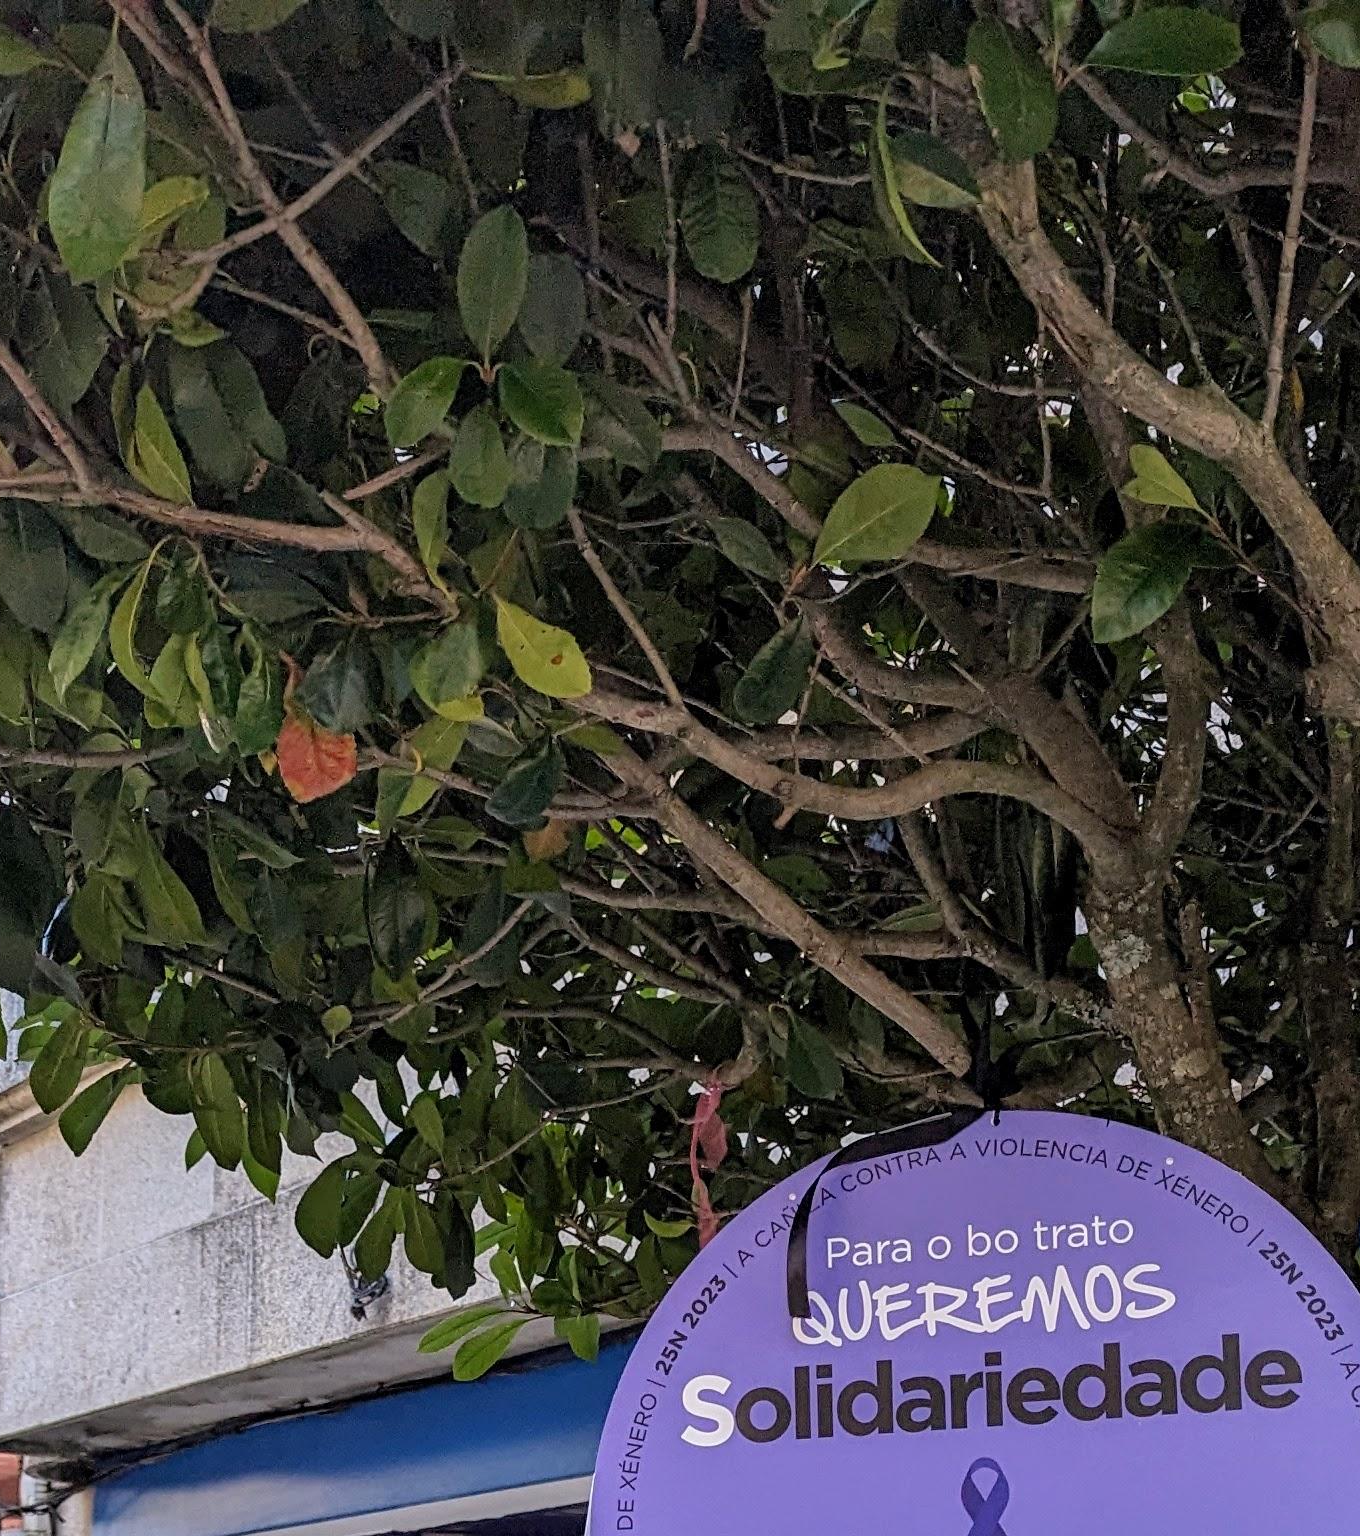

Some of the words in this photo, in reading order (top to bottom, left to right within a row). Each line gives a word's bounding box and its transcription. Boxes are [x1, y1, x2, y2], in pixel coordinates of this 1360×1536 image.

[840, 1147, 942, 1193] CONTRA
[949, 1141, 967, 1161] A
[974, 1137, 1108, 1170] VIOLENCIA
[1116, 1154, 1151, 1181] DE
[1154, 1168, 1250, 1236] XÉNERO
[737, 1248, 755, 1269] A
[826, 1236, 913, 1269] Para
[927, 1235, 952, 1261] o
[967, 1224, 1019, 1258] bo
[1032, 1213, 1135, 1252] trato
[1258, 1241, 1304, 1287] 25N
[682, 1274, 728, 1330] 2023
[791, 1262, 1177, 1348] QUEREMOS
[1295, 1283, 1346, 1342] 2023
[655, 1330, 689, 1377] 25N
[1340, 1361, 1360, 1381] A
[679, 1333, 1304, 1448] Solidariedade
[619, 1392, 658, 1491] XÉNERO
[617, 1499, 635, 1531] DE
